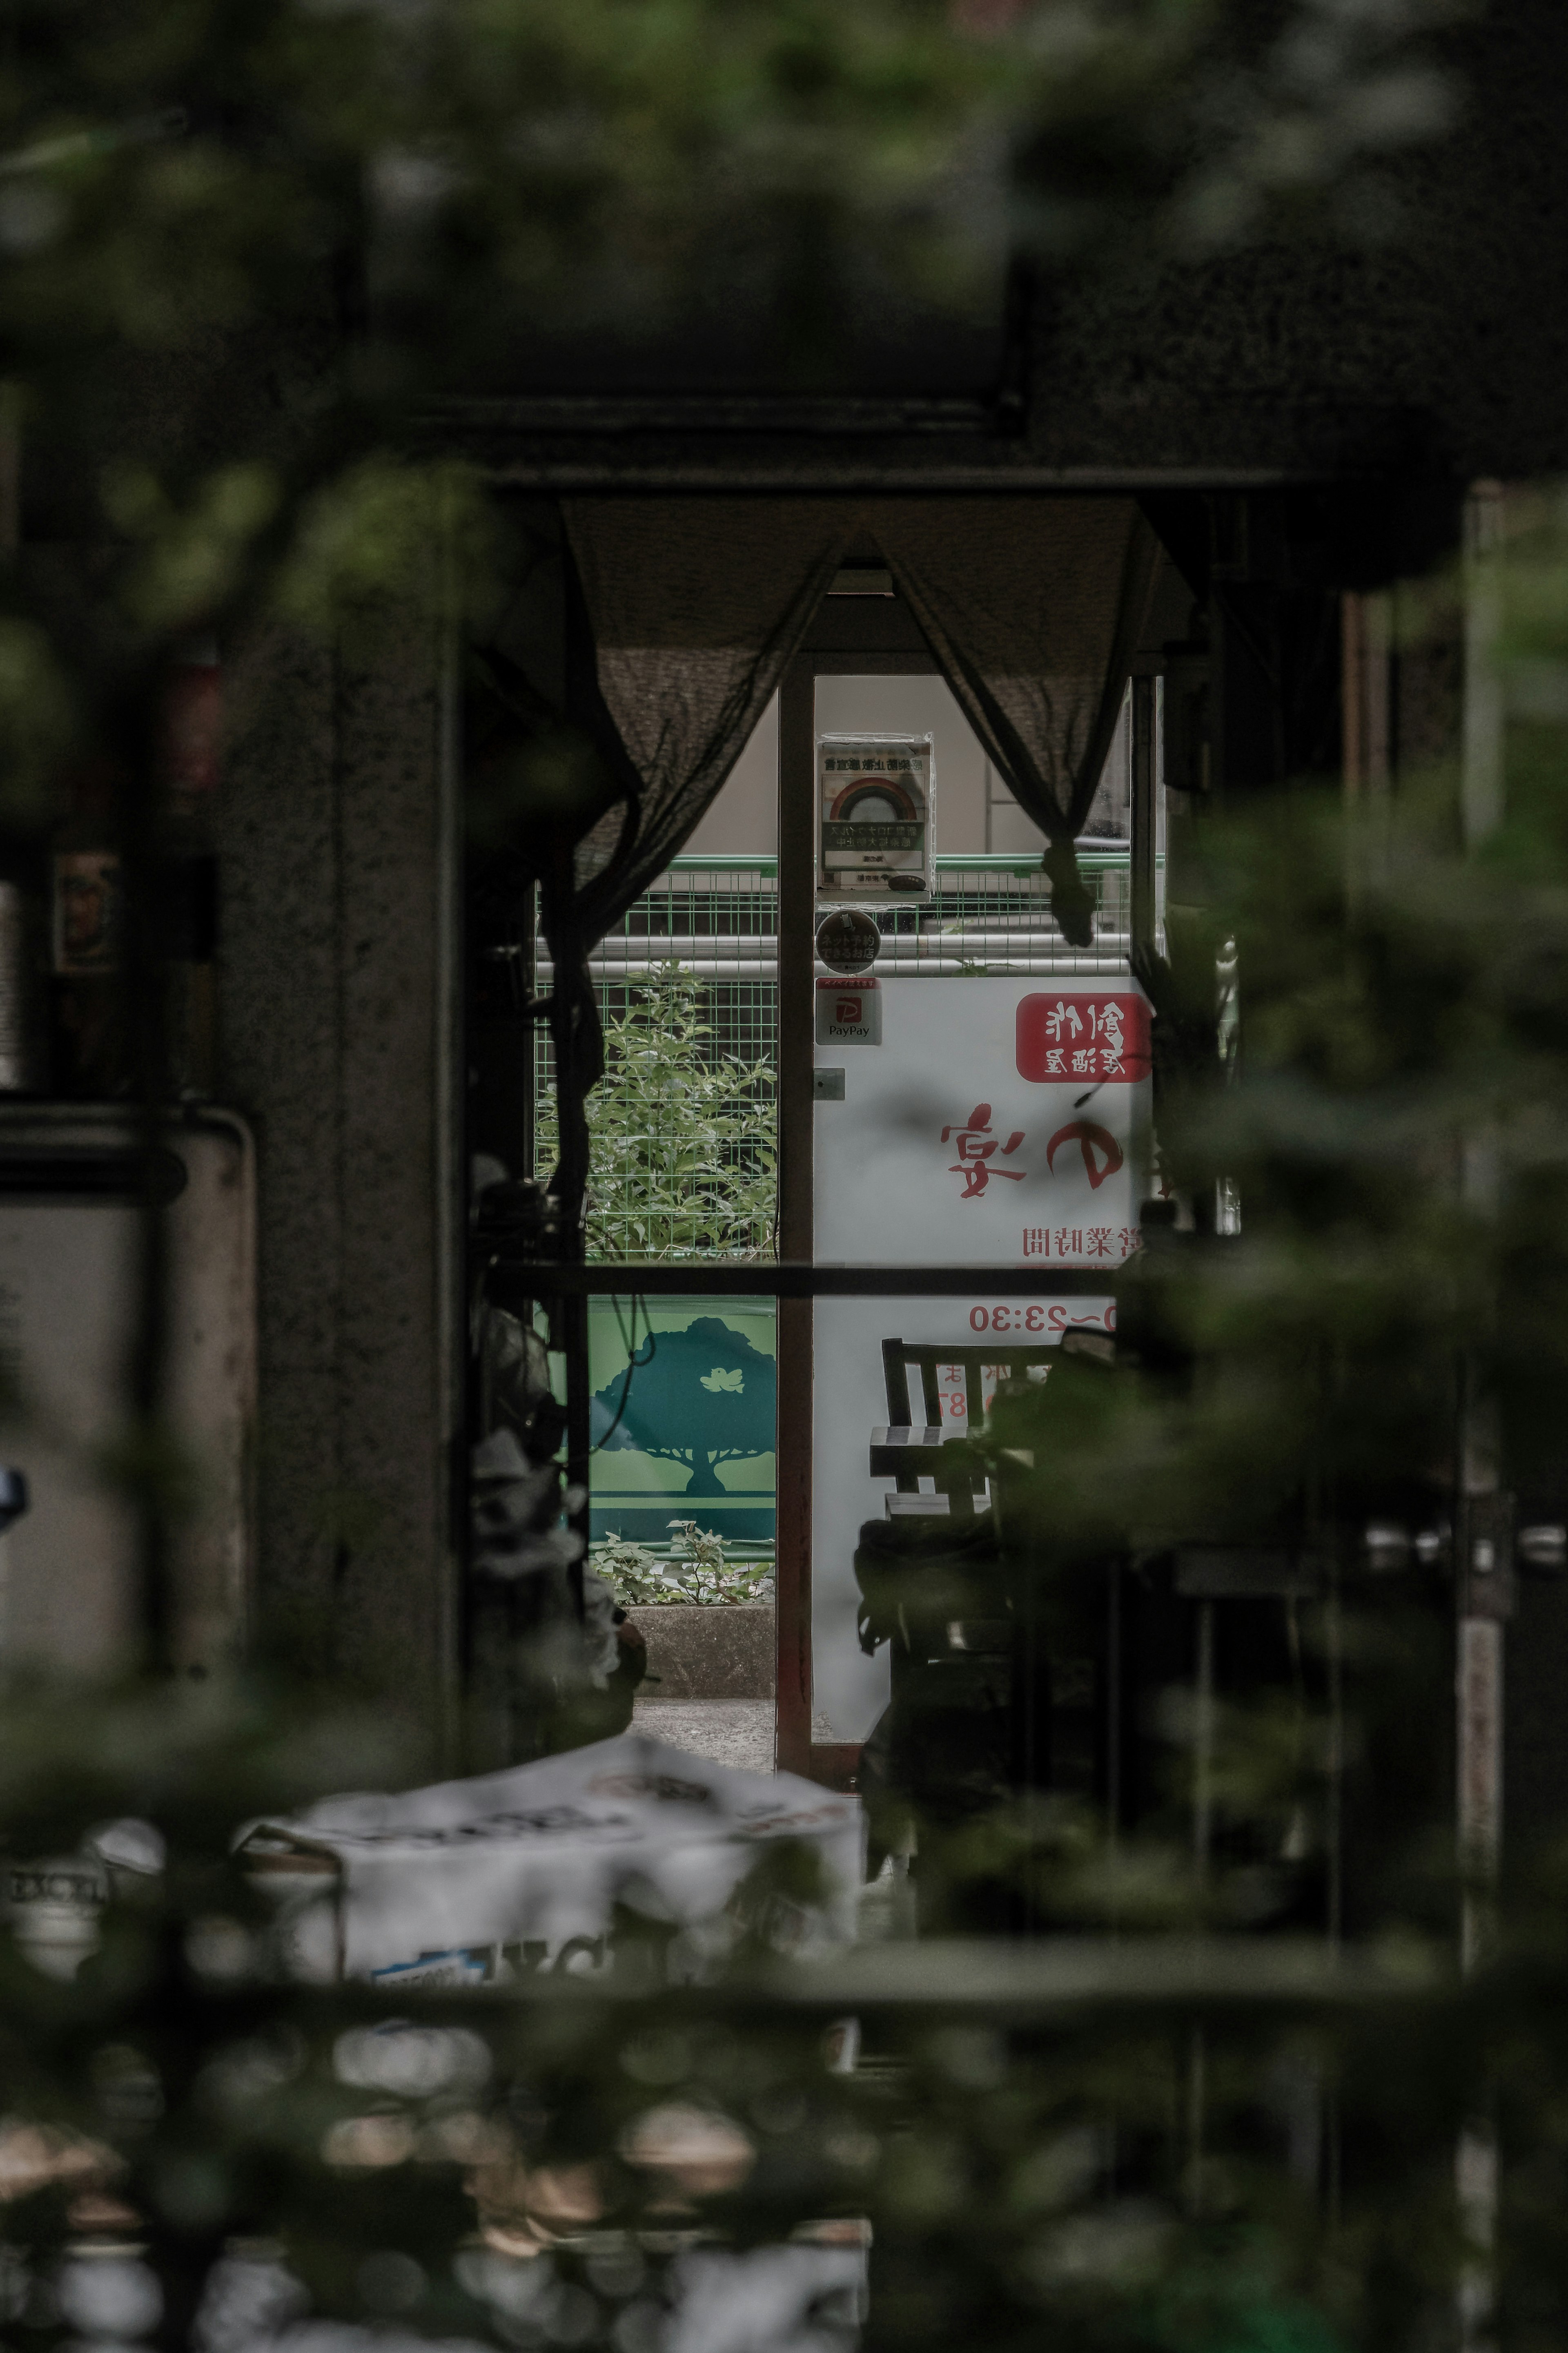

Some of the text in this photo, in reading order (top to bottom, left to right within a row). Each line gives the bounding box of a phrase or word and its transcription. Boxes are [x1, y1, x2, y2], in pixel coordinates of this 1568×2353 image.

[822, 934, 875, 947] ネット予約
[822, 947, 874, 959] できるお店
[830, 1026, 869, 1037] PayPay
